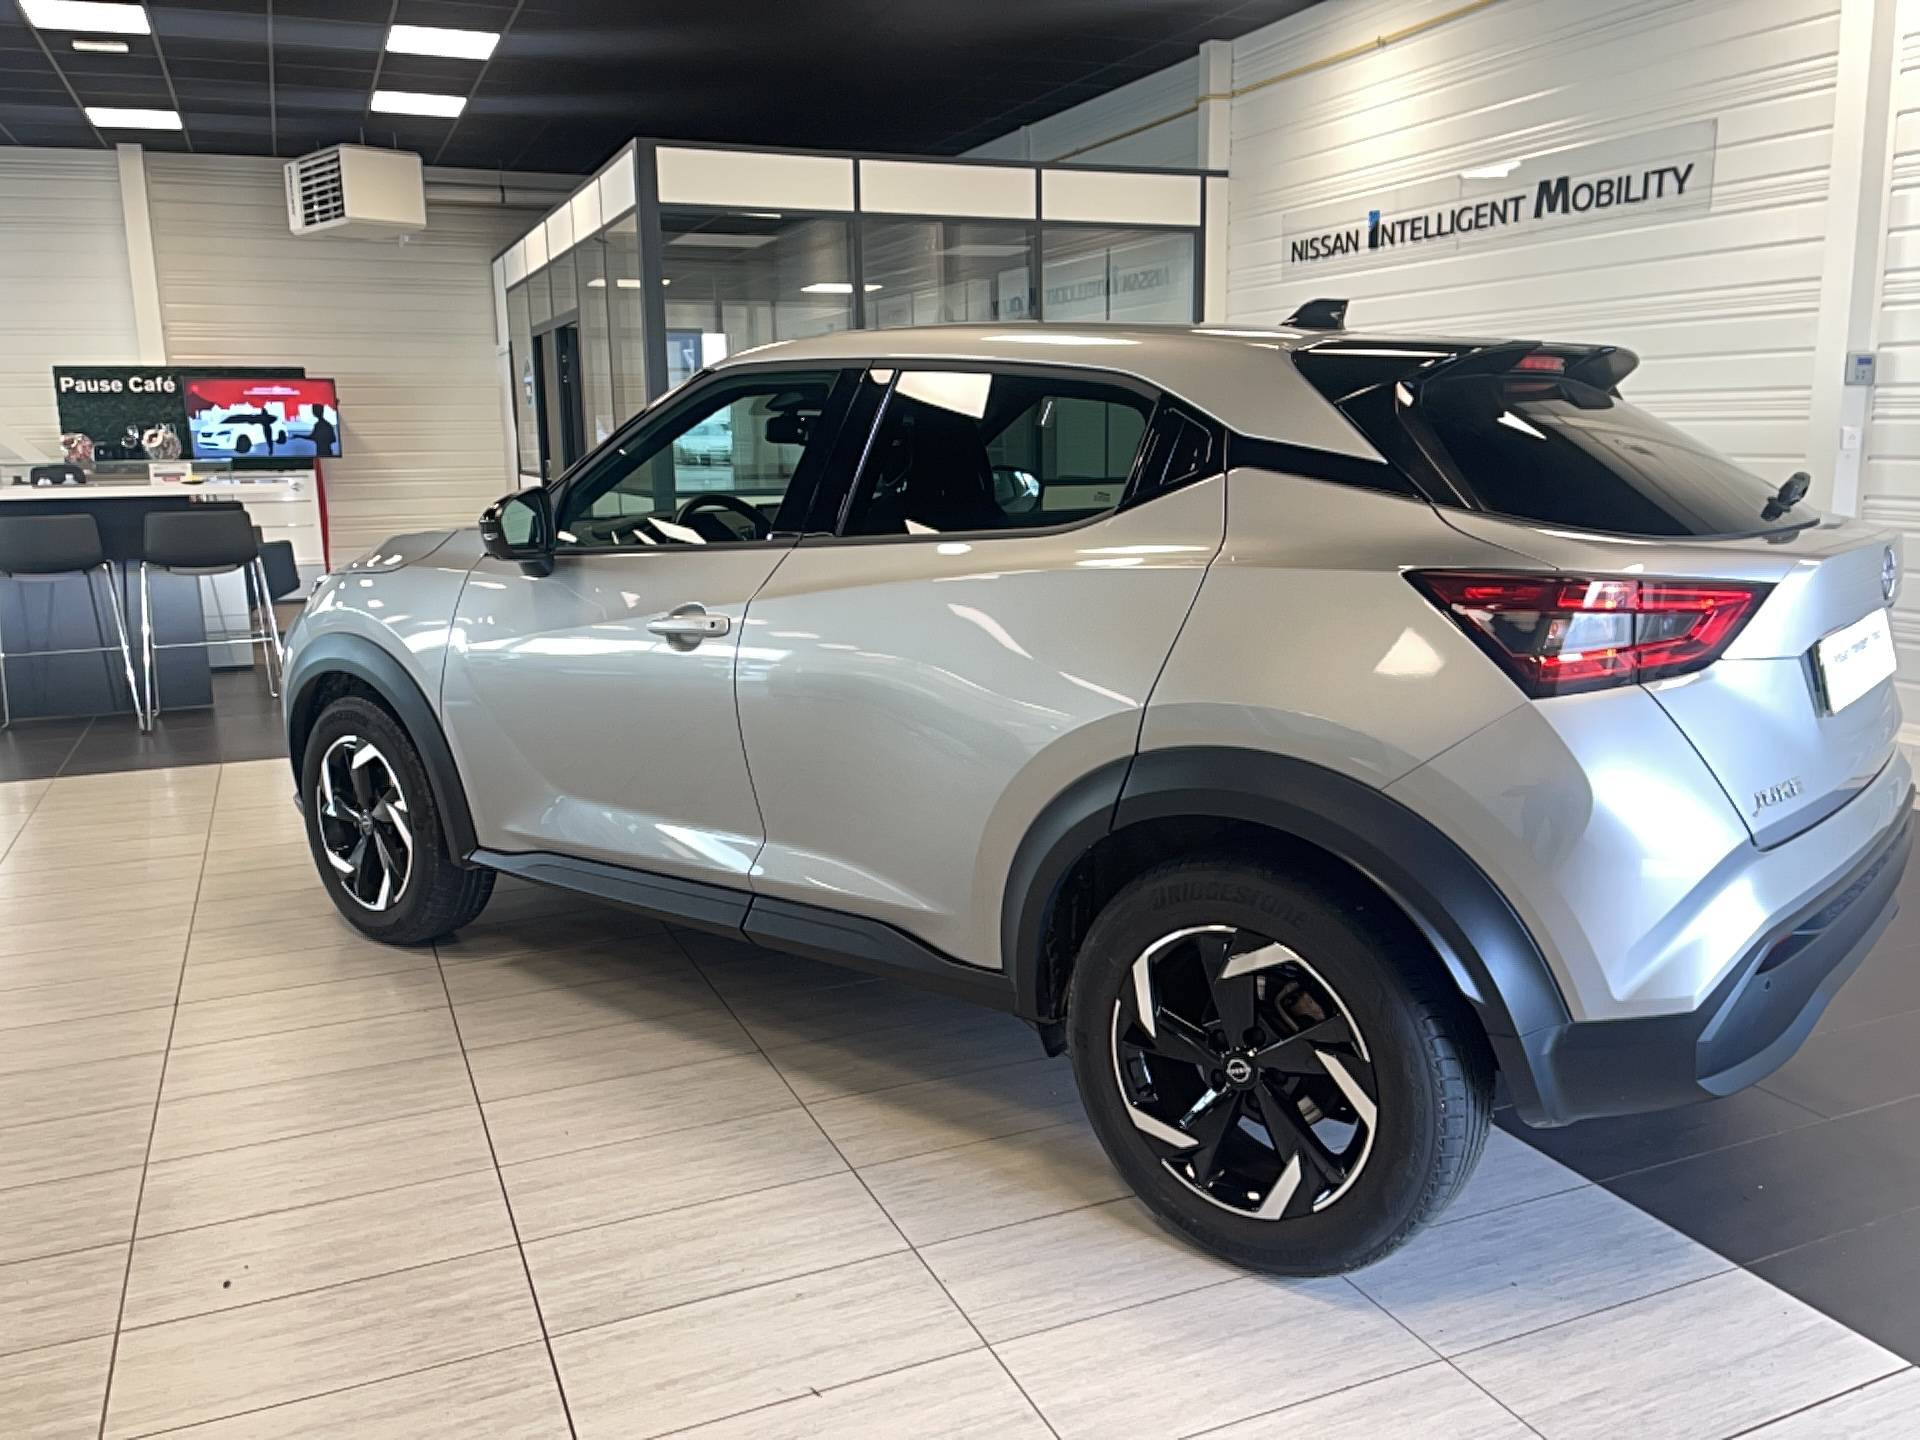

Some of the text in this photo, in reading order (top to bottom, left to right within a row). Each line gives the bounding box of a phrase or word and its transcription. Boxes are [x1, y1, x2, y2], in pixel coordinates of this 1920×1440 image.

[1291, 163, 1694, 262] NISSAN INTELLIGENT MOBILITY
[60, 375, 176, 393] Pause Café
[1752, 776, 1802, 817] JUKE
[1151, 880, 1308, 928] BRIDGESTONE
